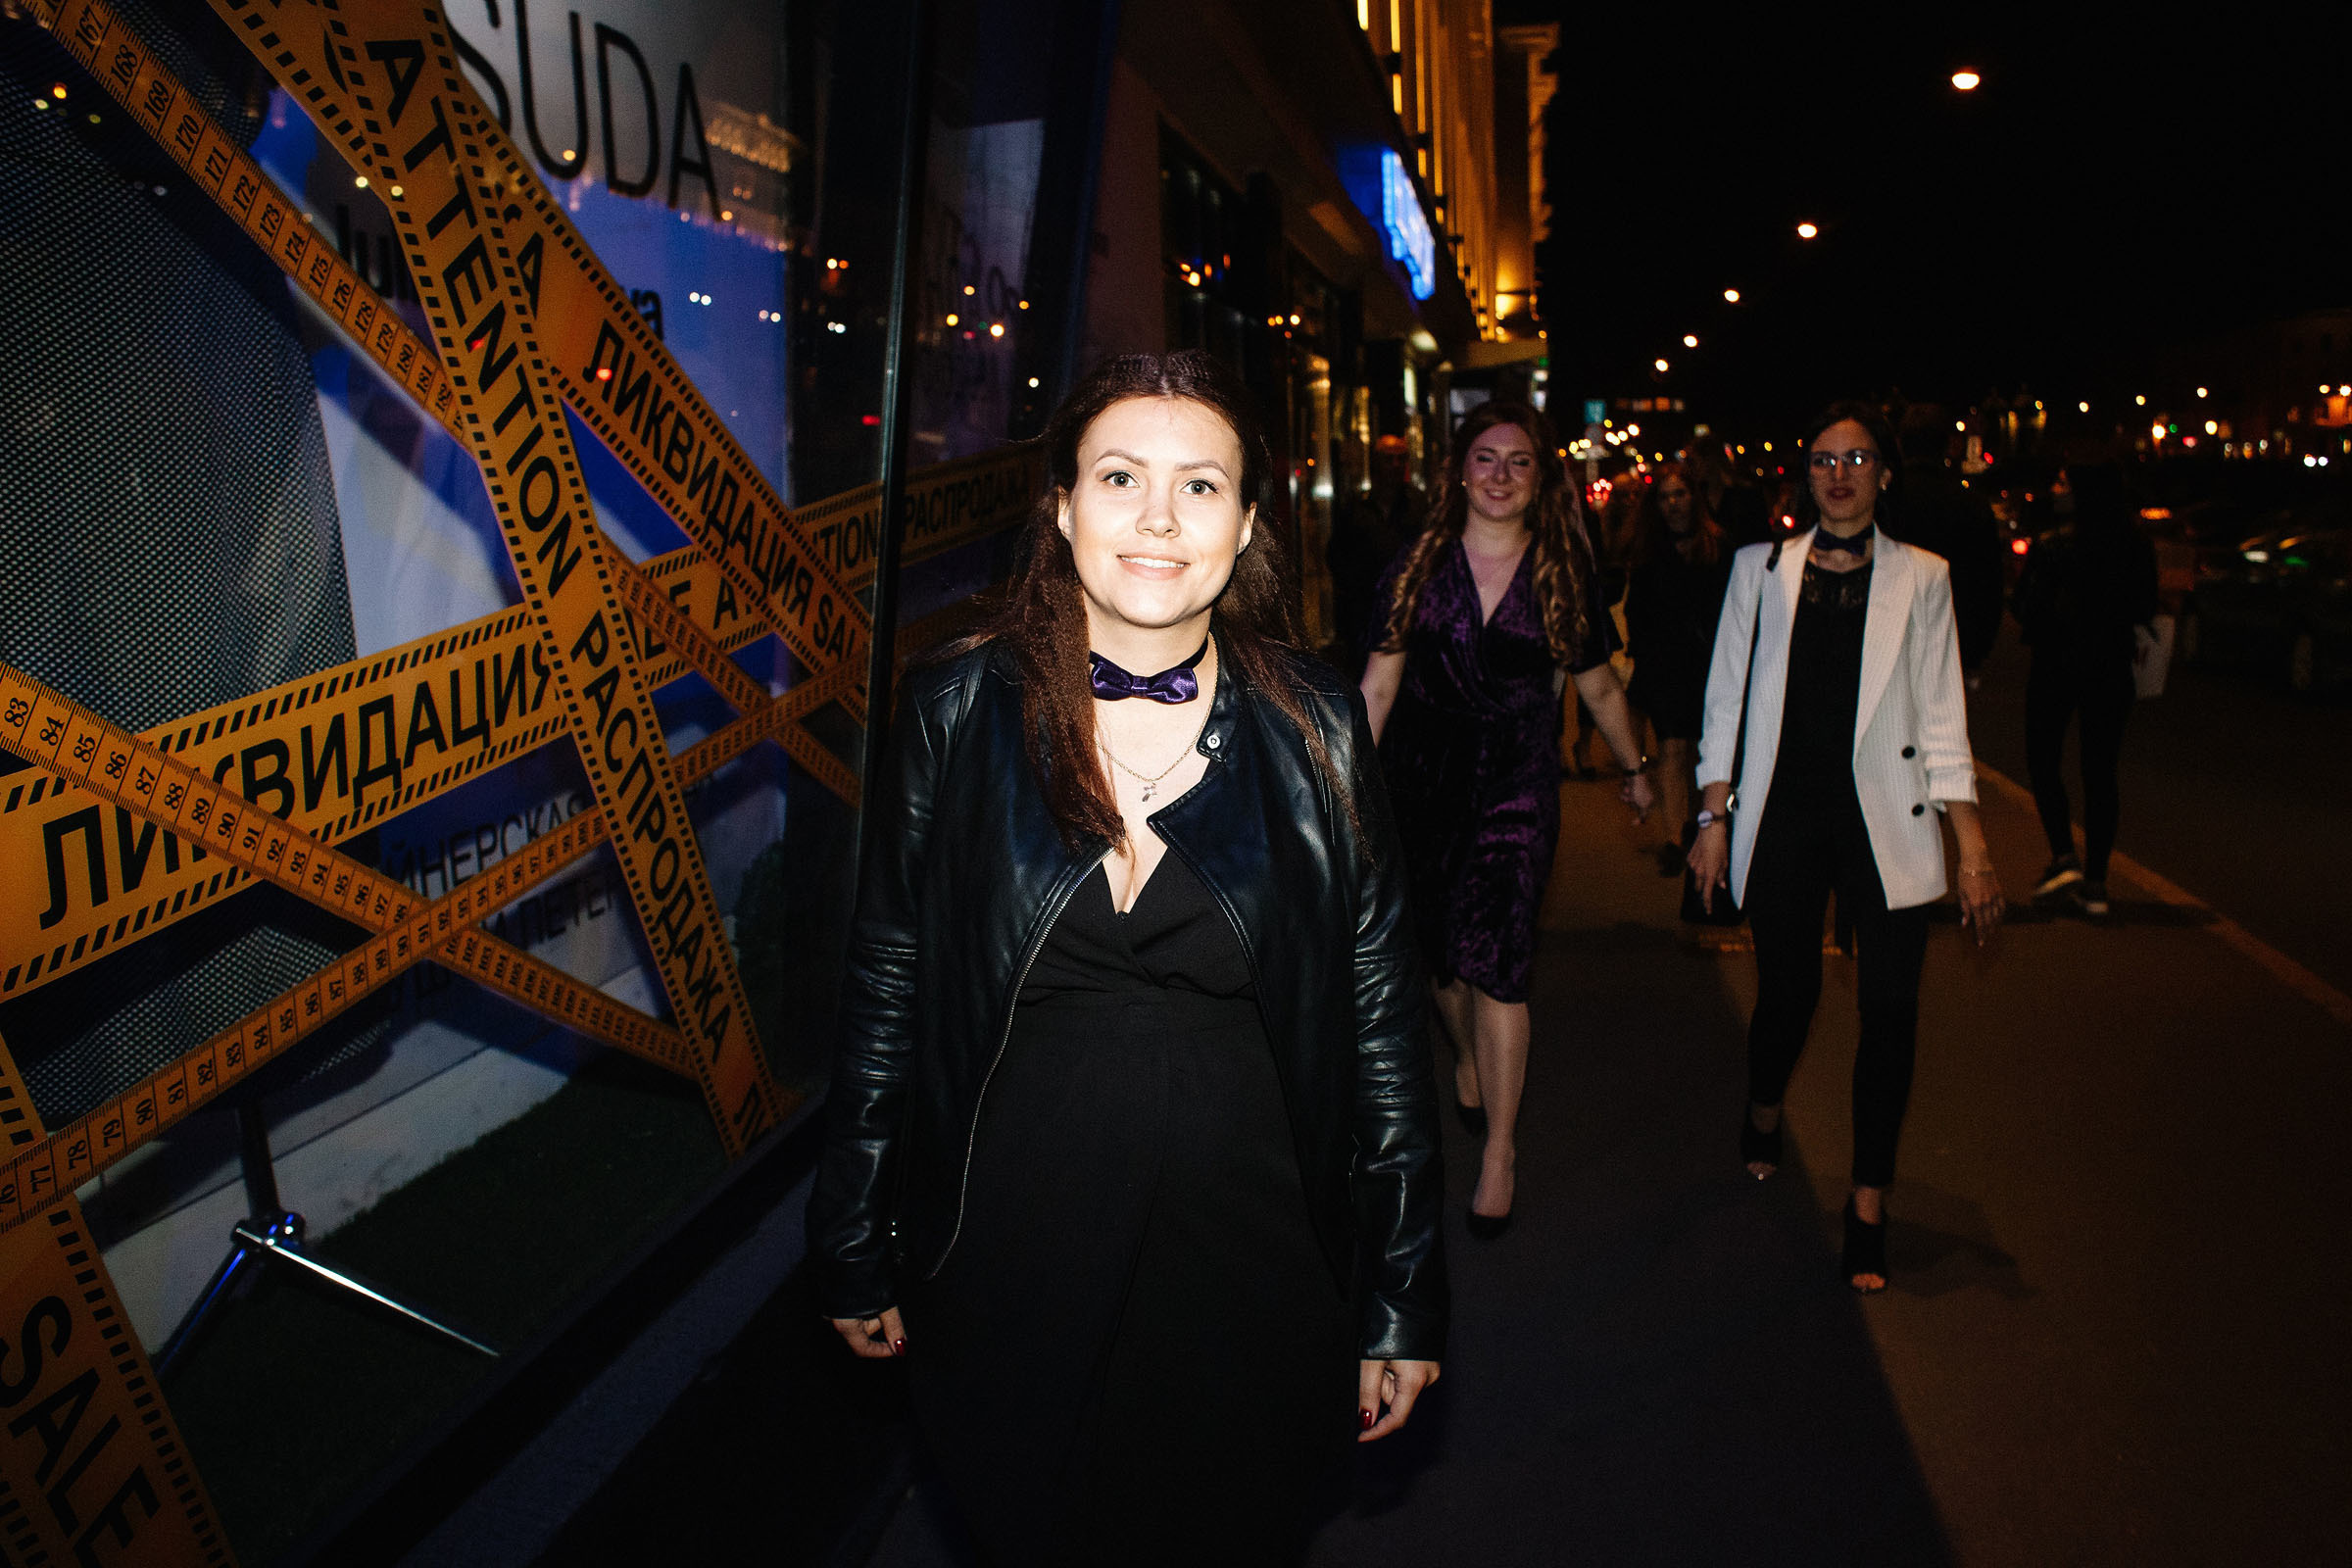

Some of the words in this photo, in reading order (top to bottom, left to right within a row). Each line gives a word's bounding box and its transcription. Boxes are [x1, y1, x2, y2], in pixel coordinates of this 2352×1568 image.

[75, 5, 105, 53] 167
[111, 44, 138, 88] 168
[144, 80, 170, 122] 169
[174, 114, 200, 154] 170
[204, 147, 228, 184] 171
[233, 175, 257, 213] 172
[259, 203, 280, 238] 173
[285, 231, 306, 263] 174
[309, 255, 329, 288] 175
[355, 301, 372, 333] 178
[376, 323, 394, 354] 179
[396, 344, 413, 373] 180
[416, 366, 432, 394] 181
[365, 39, 582, 598] ATTENTION
[570, 609, 731, 1065] РАСПРОДАЖА
[583, 319, 813, 626] ЛИКВИДАЦИЯ
[4, 697, 29, 727] 83
[39, 716, 65, 746] 84
[73, 733, 96, 762] 85
[104, 751, 127, 779] 86
[135, 766, 156, 795] 87
[164, 782, 184, 809] 88
[191, 798, 211, 825] 89
[218, 812, 236, 839] 90
[243, 827, 262, 851] 91
[267, 838, 285, 863] 92
[290, 851, 308, 875] 93
[312, 862, 329, 887] 94
[333, 873, 350, 897] 95
[354, 883, 370, 906] 96
[374, 893, 390, 917] 97
[29, 1164, 51, 1194] 77
[68, 1139, 87, 1170] 78
[103, 1118, 122, 1148] 79
[135, 1098, 154, 1125] 80
[167, 1079, 185, 1105] 81
[197, 1058, 215, 1086] 82
[225, 1042, 243, 1067] 83
[253, 1025, 270, 1050] 84
[279, 1008, 294, 1033] 85
[304, 992, 320, 1016] 86
[328, 979, 343, 1001] 87
[353, 962, 366, 986] 88
[374, 949, 387, 971] 89
[397, 934, 409, 956] 90
[417, 922, 429, 944] 91
